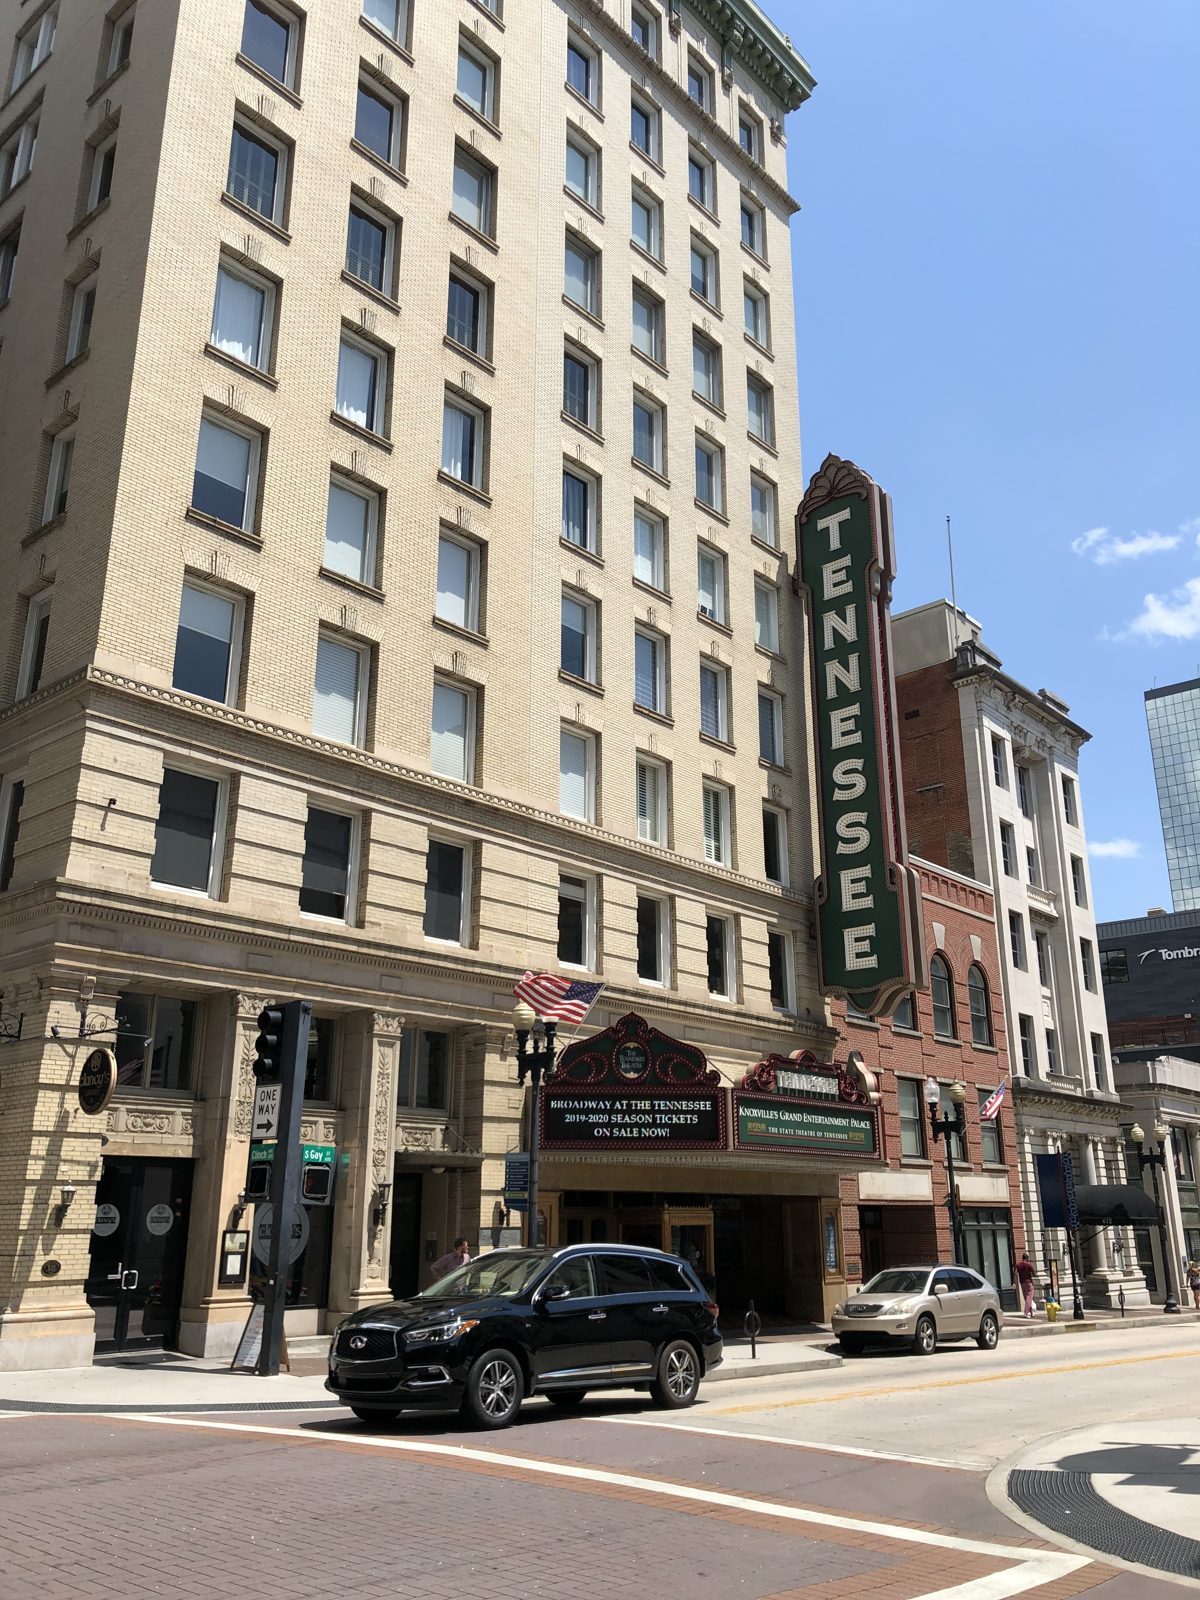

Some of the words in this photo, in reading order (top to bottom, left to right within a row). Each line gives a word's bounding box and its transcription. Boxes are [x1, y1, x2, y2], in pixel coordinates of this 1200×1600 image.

[817, 508, 878, 971] TENNESSEE
[1159, 946, 1200, 960] Tombr
[777, 1070, 840, 1095] TENNESSEE
[260, 1089, 277, 1102] ONE
[258, 1103, 276, 1115] WAY
[550, 1100, 611, 1110] BROADWAY
[614, 1100, 629, 1110] AT
[630, 1101, 651, 1110] THE
[653, 1101, 712, 1110] TENNESSEE
[564, 1114, 609, 1123] 2019-2020
[610, 1114, 653, 1123] SEASON
[655, 1114, 698, 1124] TICKETS
[739, 1105, 779, 1119] KNOXVILLE'S
[780, 1110, 803, 1122] GRAND
[803, 1113, 849, 1127] ENTERTAINMENT
[850, 1118, 871, 1129] PALACE
[594, 1127, 610, 1137] ON
[612, 1127, 639, 1137] SALE
[641, 1127, 670, 1137] NOW!
[768, 1126, 778, 1134] THE
[779, 1127, 794, 1135] STATE
[795, 1129, 816, 1137] THEATRE
[824, 1132, 848, 1140] TENNESSEE
[251, 1150, 267, 1160] Clinch
[310, 1149, 323, 1162] Gay
